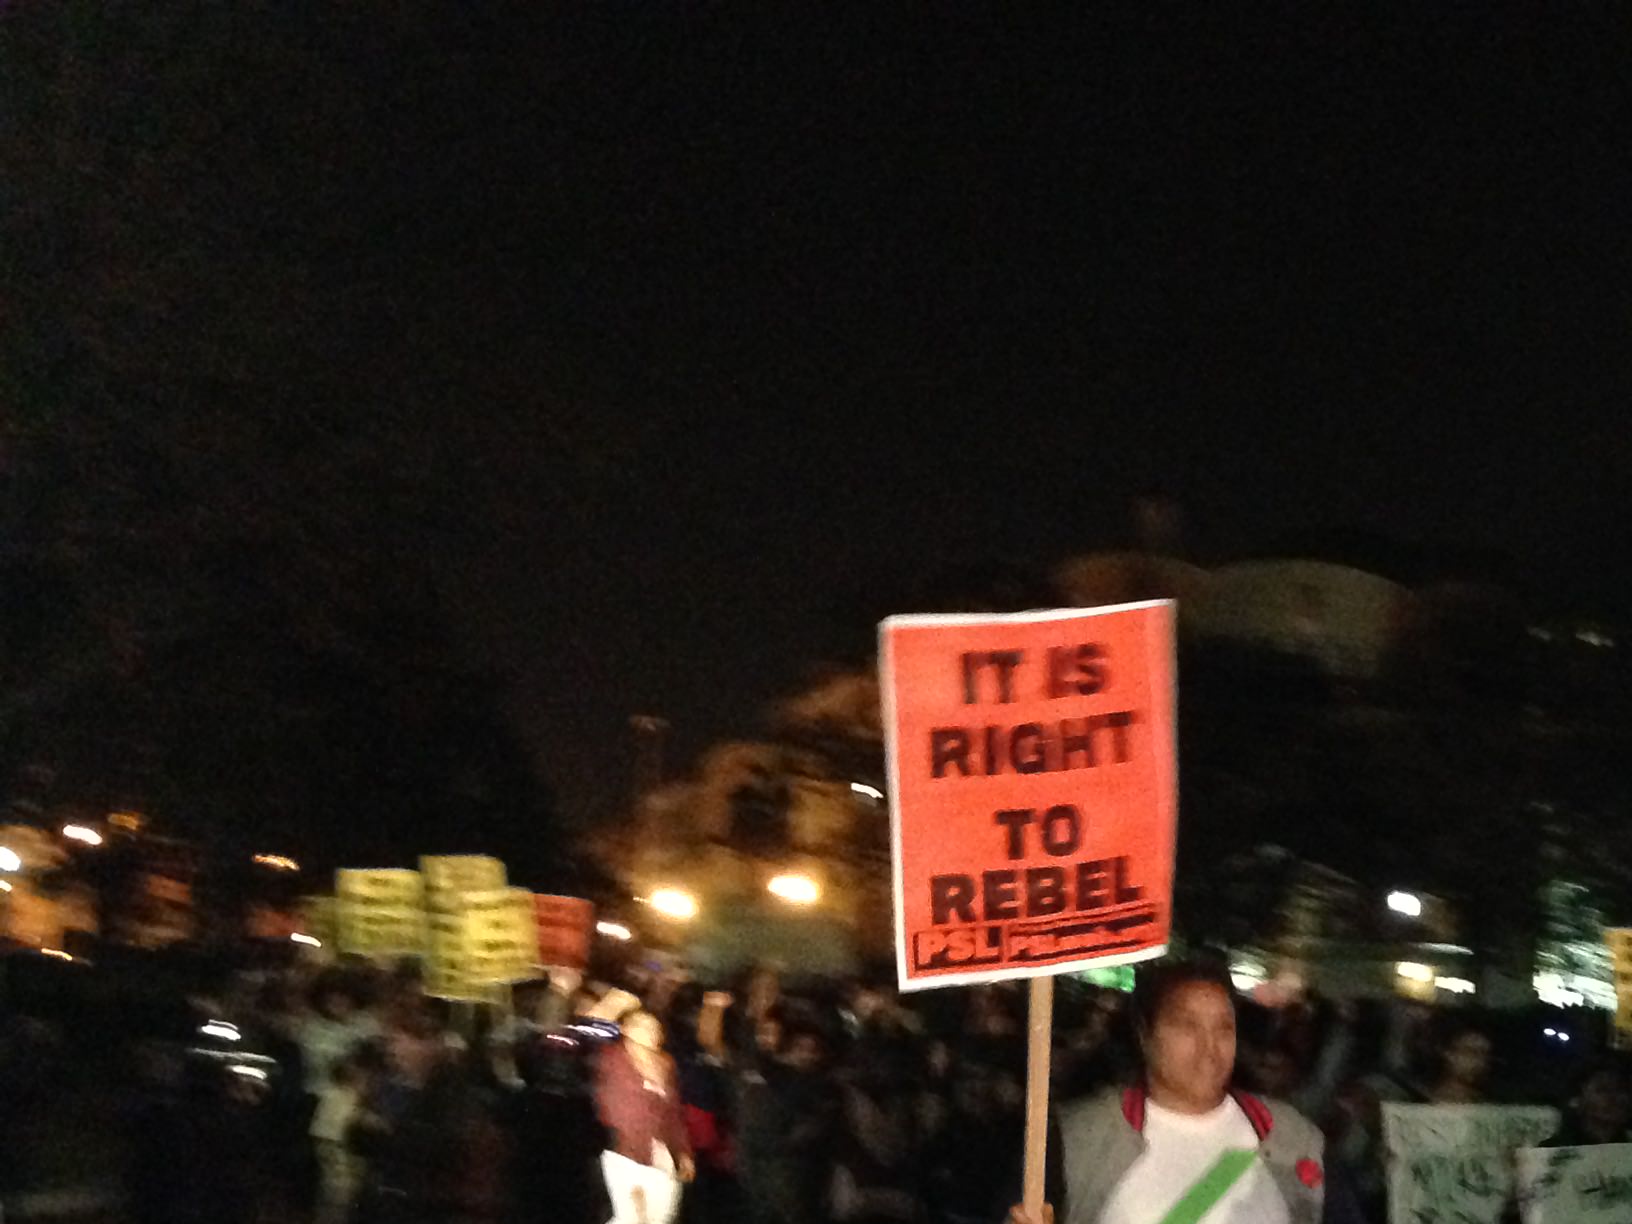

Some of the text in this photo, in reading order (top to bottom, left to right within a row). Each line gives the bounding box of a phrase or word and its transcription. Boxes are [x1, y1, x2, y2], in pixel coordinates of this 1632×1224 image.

[961, 642, 1108, 704] IT IS
[930, 709, 1136, 779] RIGHT
[995, 803, 1082, 860] TO
[930, 855, 1145, 925] REBEL
